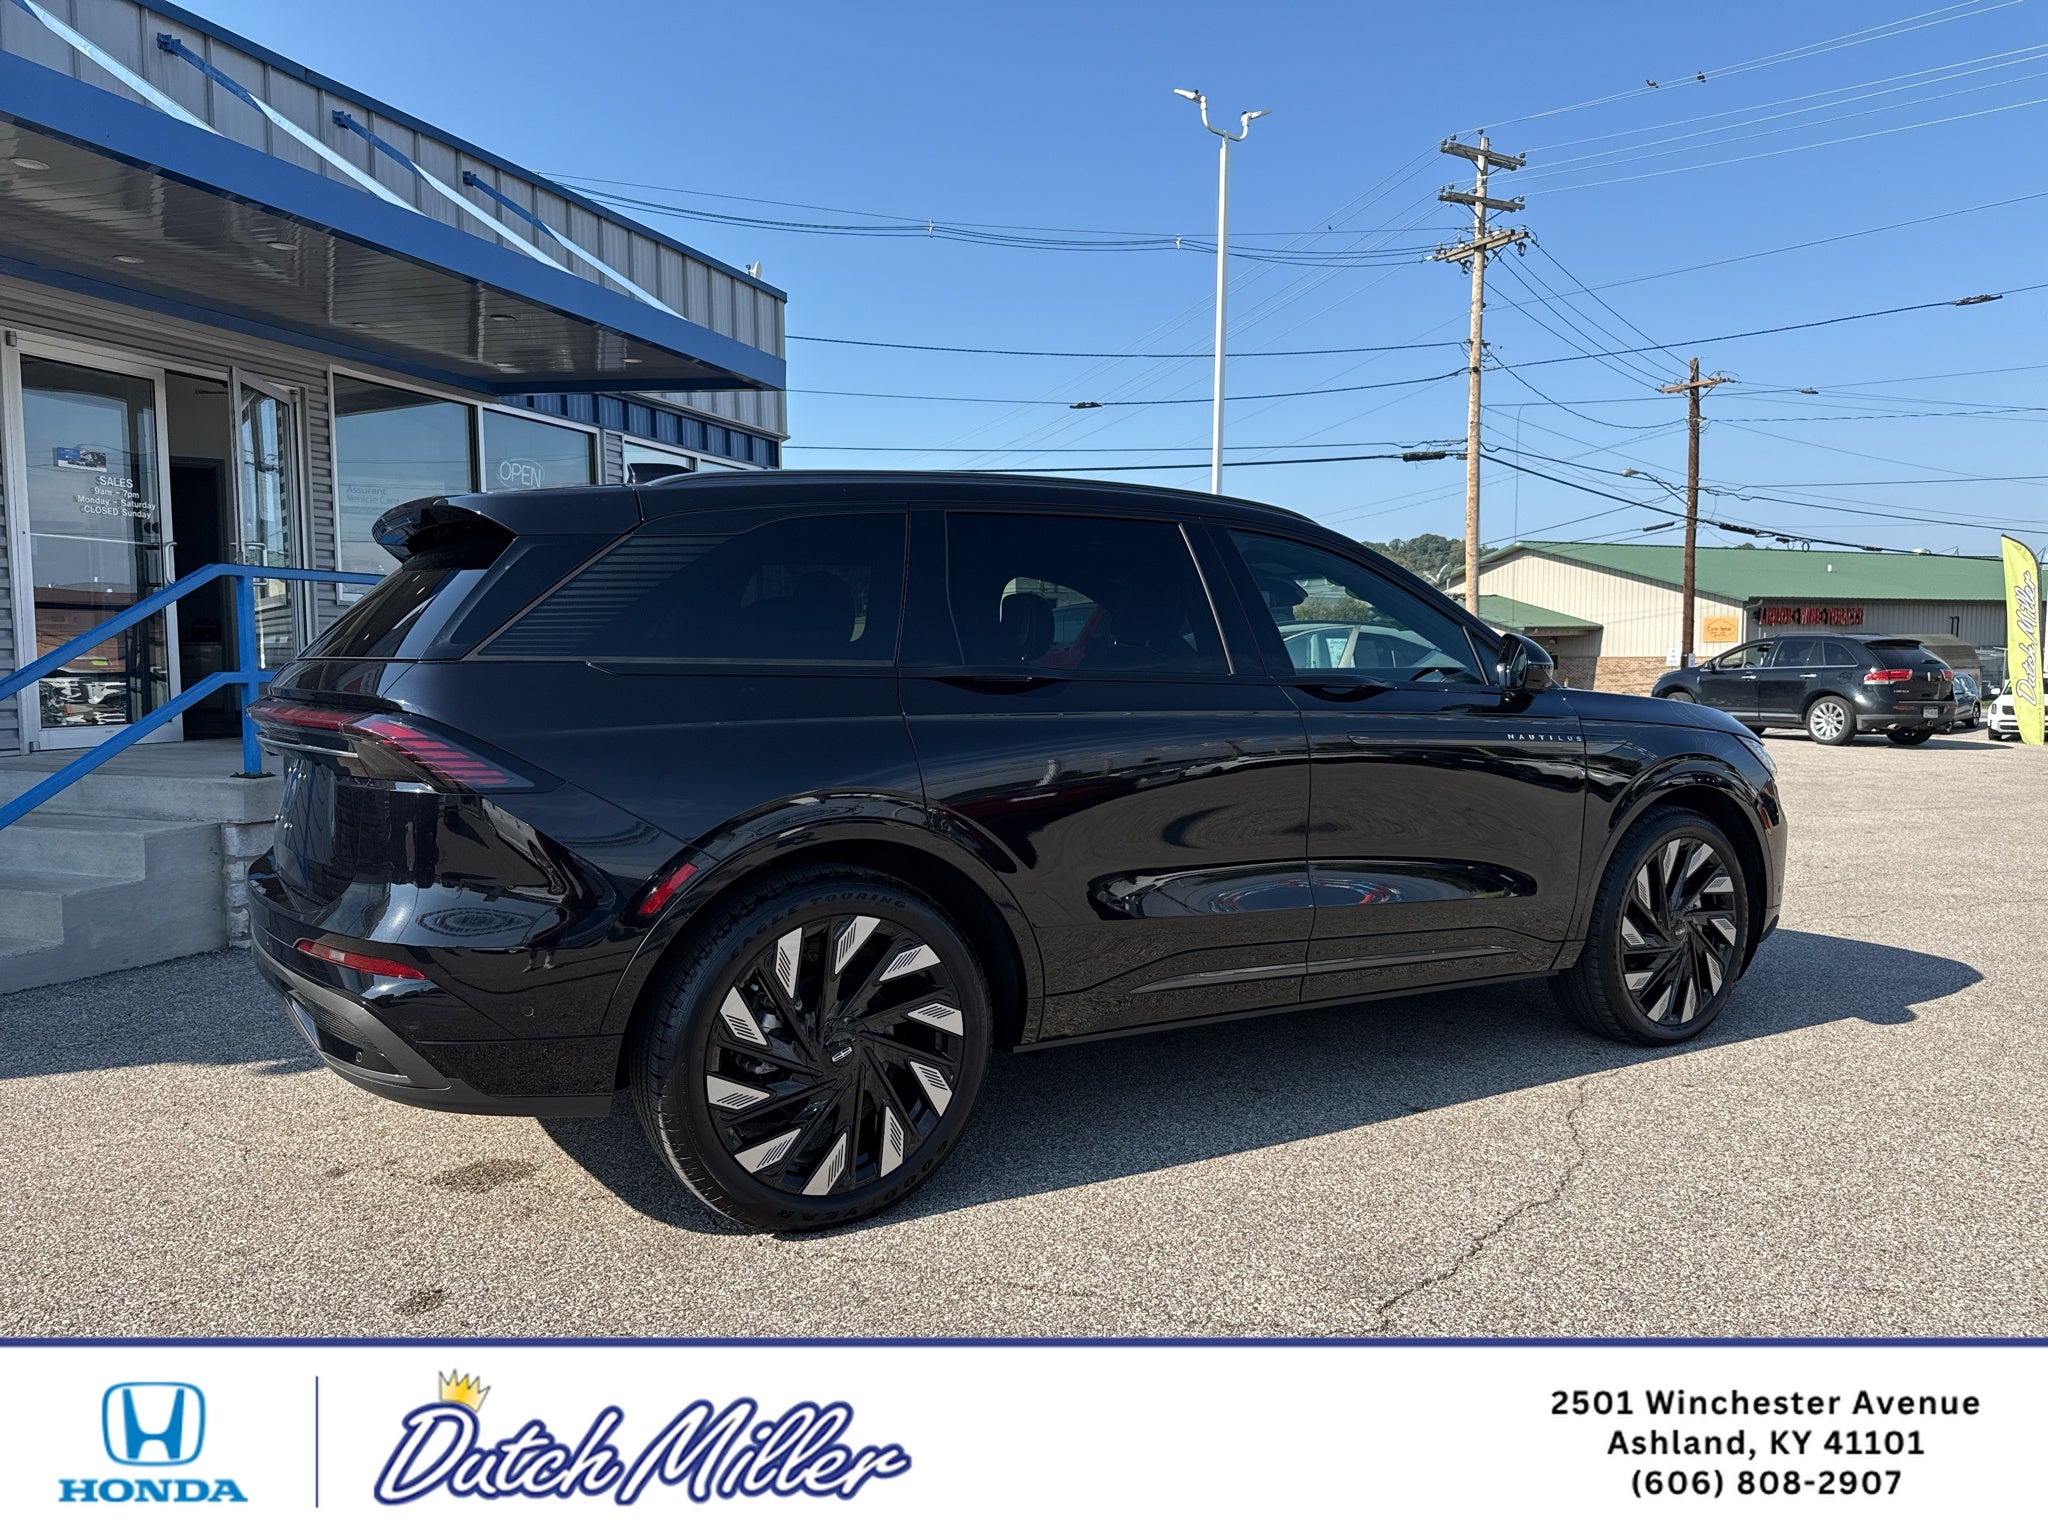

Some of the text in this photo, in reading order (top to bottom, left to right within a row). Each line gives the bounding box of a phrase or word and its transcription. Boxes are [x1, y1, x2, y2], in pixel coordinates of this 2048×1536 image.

[99, 476, 134, 488] SALES
[499, 461, 542, 489] OPEN
[94, 487, 113, 496] 9am
[122, 489, 140, 499] 7pm
[346, 486, 387, 496] Assurant
[77, 495, 110, 506] Monday
[121, 498, 156, 511] Saturday
[84, 505, 151, 519] CLOSED Sunday
[1759, 607, 1864, 626] LIQUOR WINE TOBACCO
[2014, 571, 2039, 707] Dutch Miller
[1507, 733, 1582, 742] NAUTILUS
[729, 892, 908, 960] EAGLE TOURING
